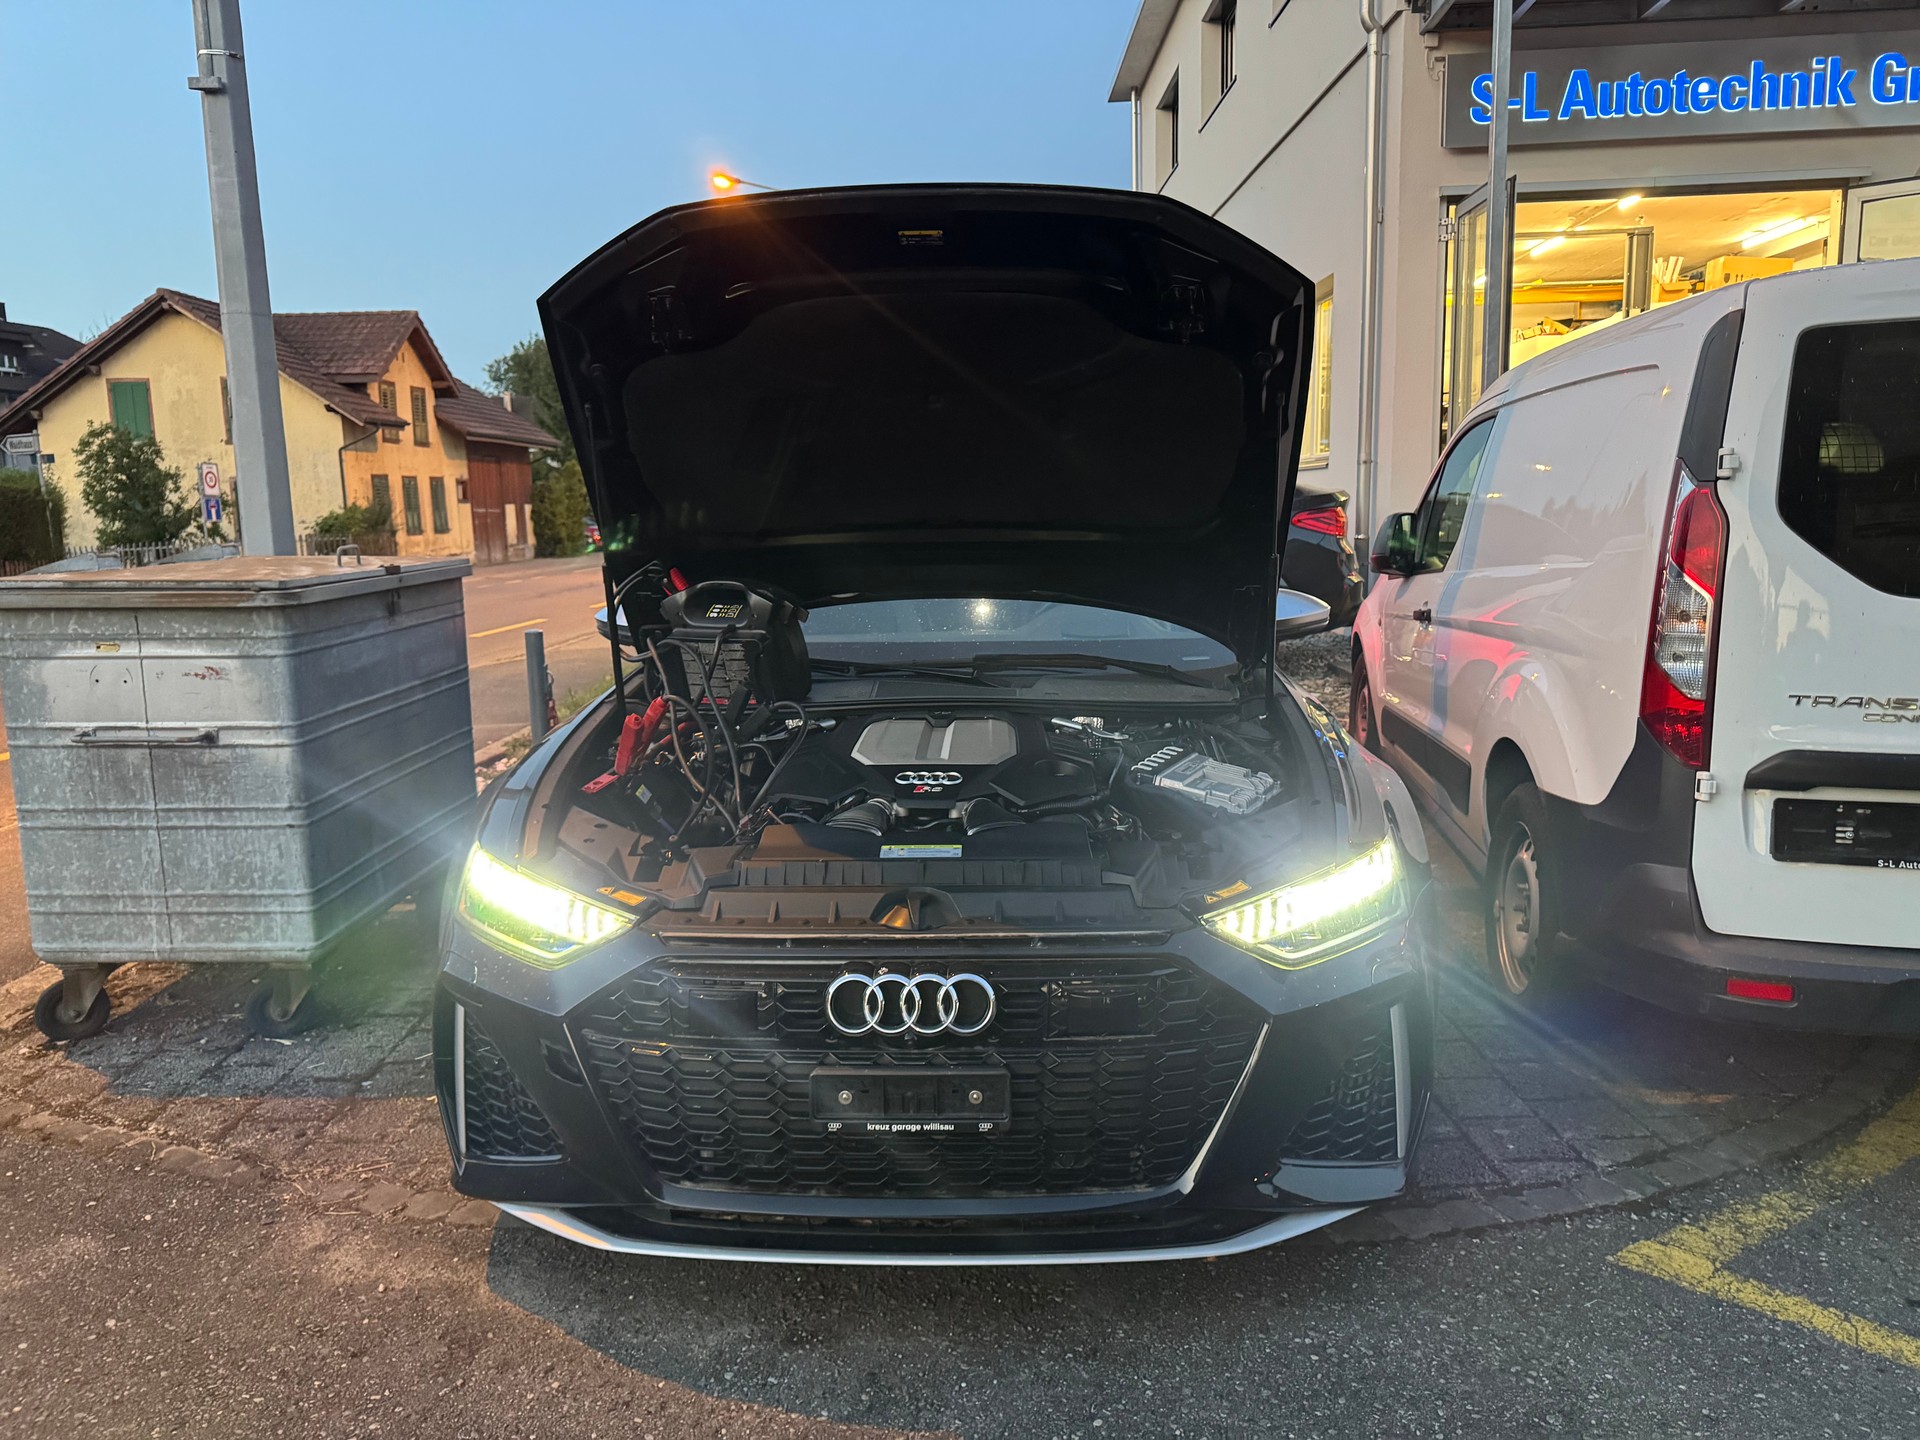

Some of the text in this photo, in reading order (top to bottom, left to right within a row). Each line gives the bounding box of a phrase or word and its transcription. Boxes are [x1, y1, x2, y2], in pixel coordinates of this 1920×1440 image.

[1469, 71, 1550, 124] S-L
[1557, 55, 1858, 121] Autotechnik
[1788, 694, 1920, 710] TRANS
[1877, 859, 1896, 868] S-L
[867, 1122, 955, 1132] kreuz garage willisau
